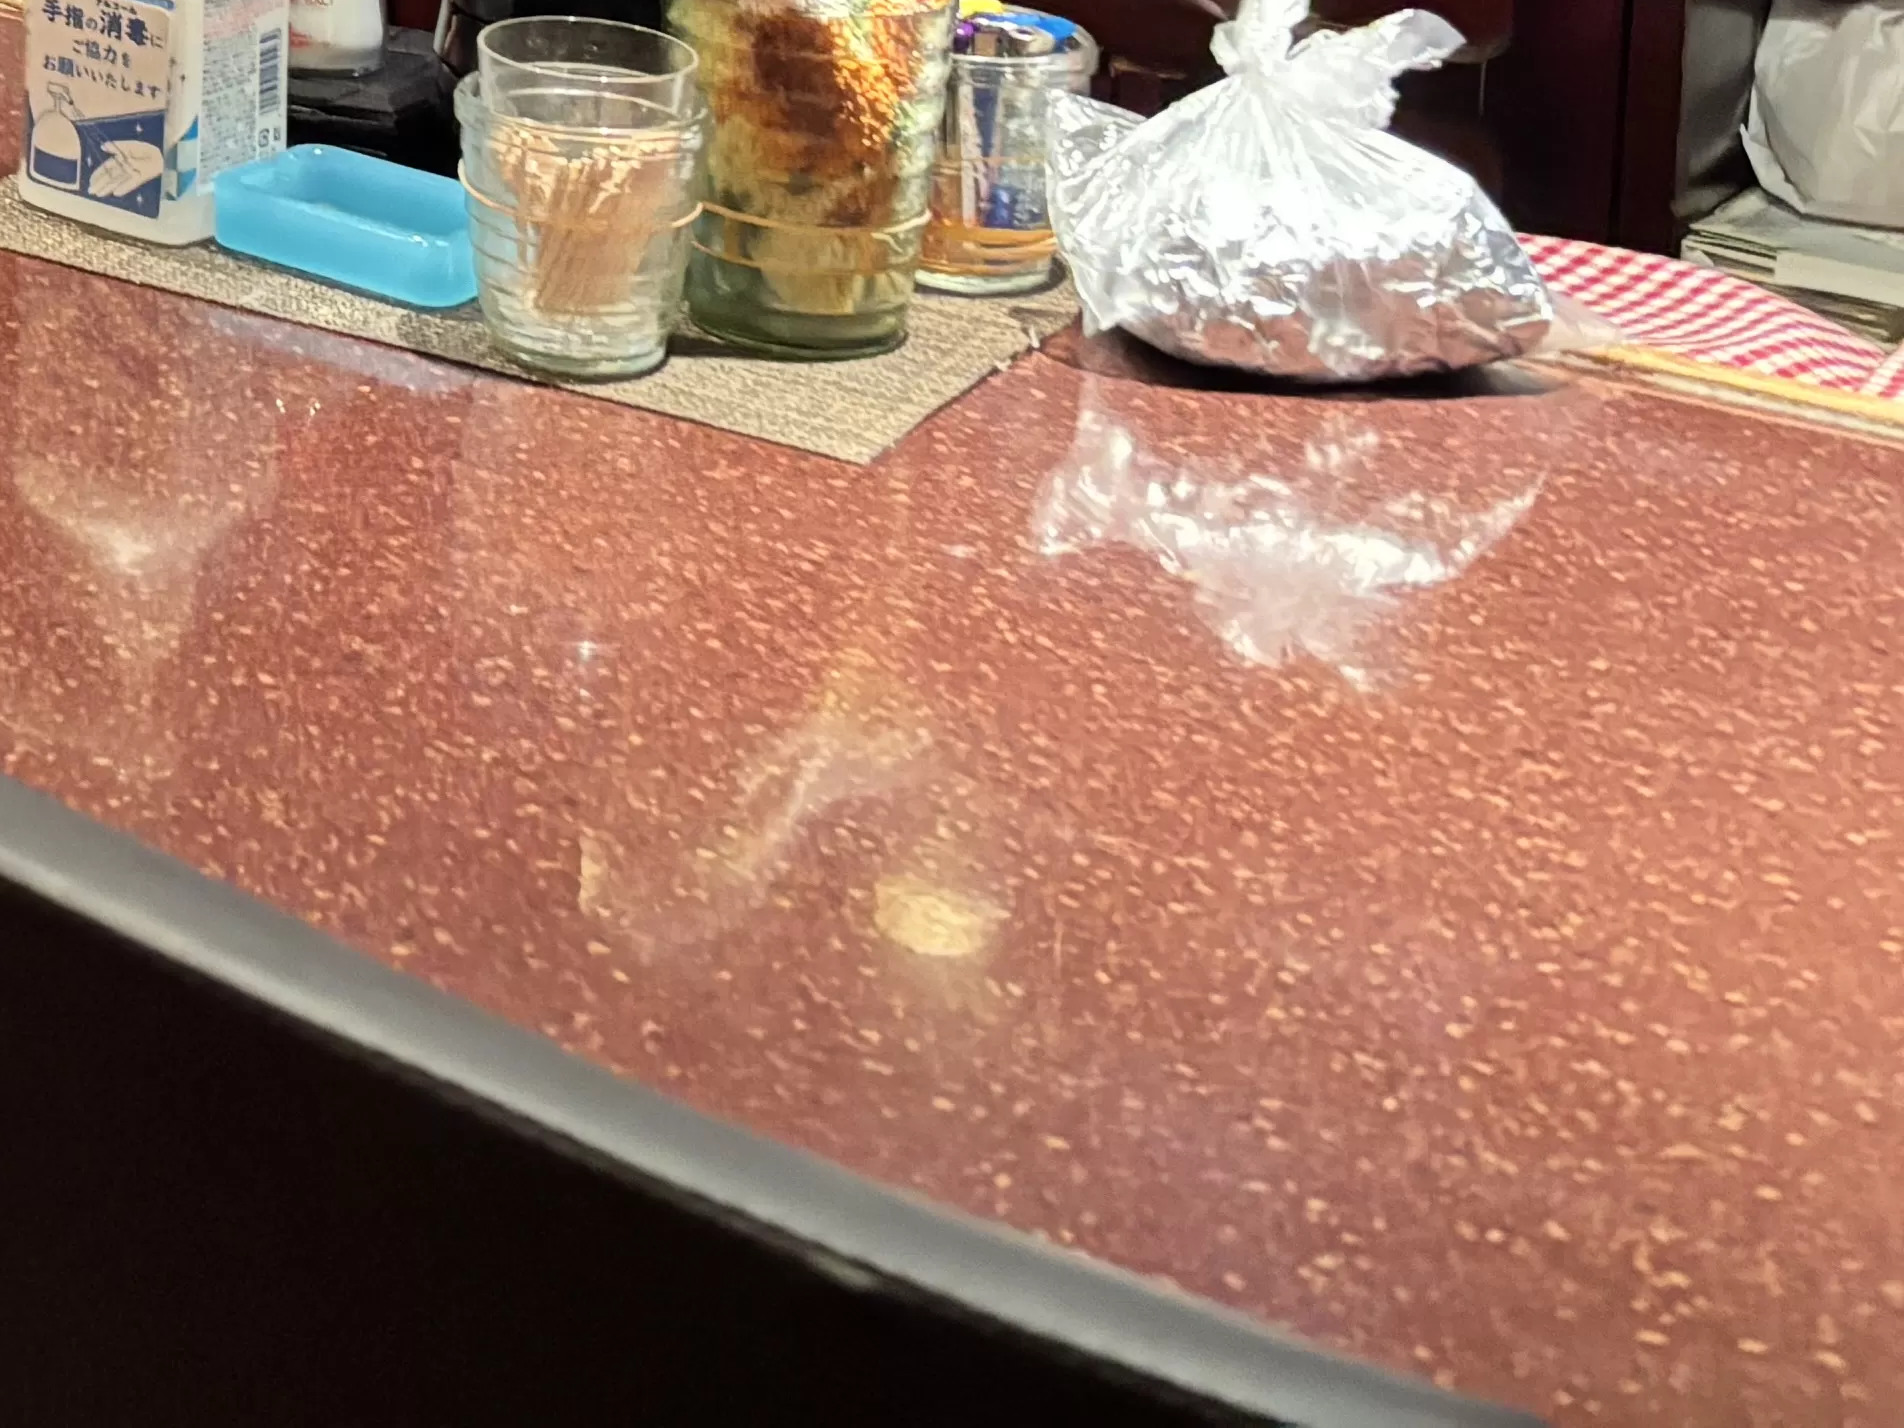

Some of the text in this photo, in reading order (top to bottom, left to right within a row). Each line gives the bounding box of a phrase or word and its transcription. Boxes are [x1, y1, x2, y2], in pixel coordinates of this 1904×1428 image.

[72, 38, 132, 69] ご協力を
[42, 54, 161, 100] お願いいたします
